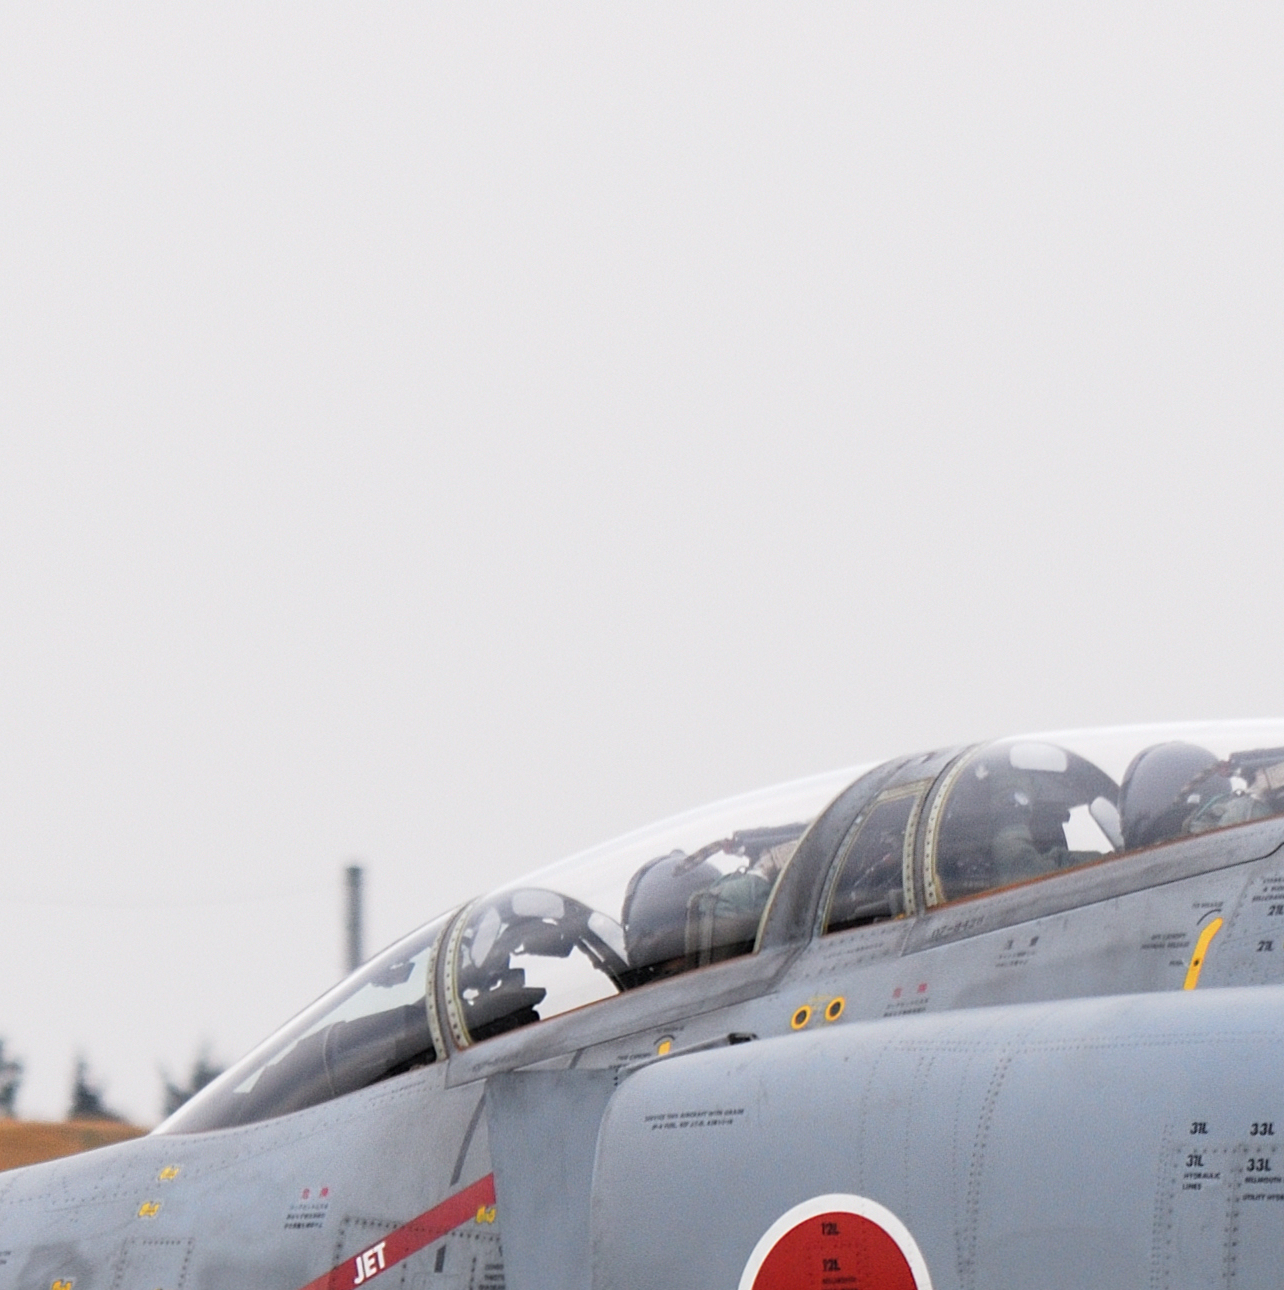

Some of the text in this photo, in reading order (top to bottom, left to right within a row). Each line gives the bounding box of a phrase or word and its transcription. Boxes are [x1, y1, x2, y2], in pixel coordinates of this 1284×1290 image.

[1189, 1121, 1209, 1135] 31L
[1249, 1122, 1276, 1136] 33L
[1246, 1158, 1272, 1172] 33L
[821, 1221, 841, 1236] 12L
[353, 1240, 387, 1286] JET
[822, 1258, 841, 1272] 12L
